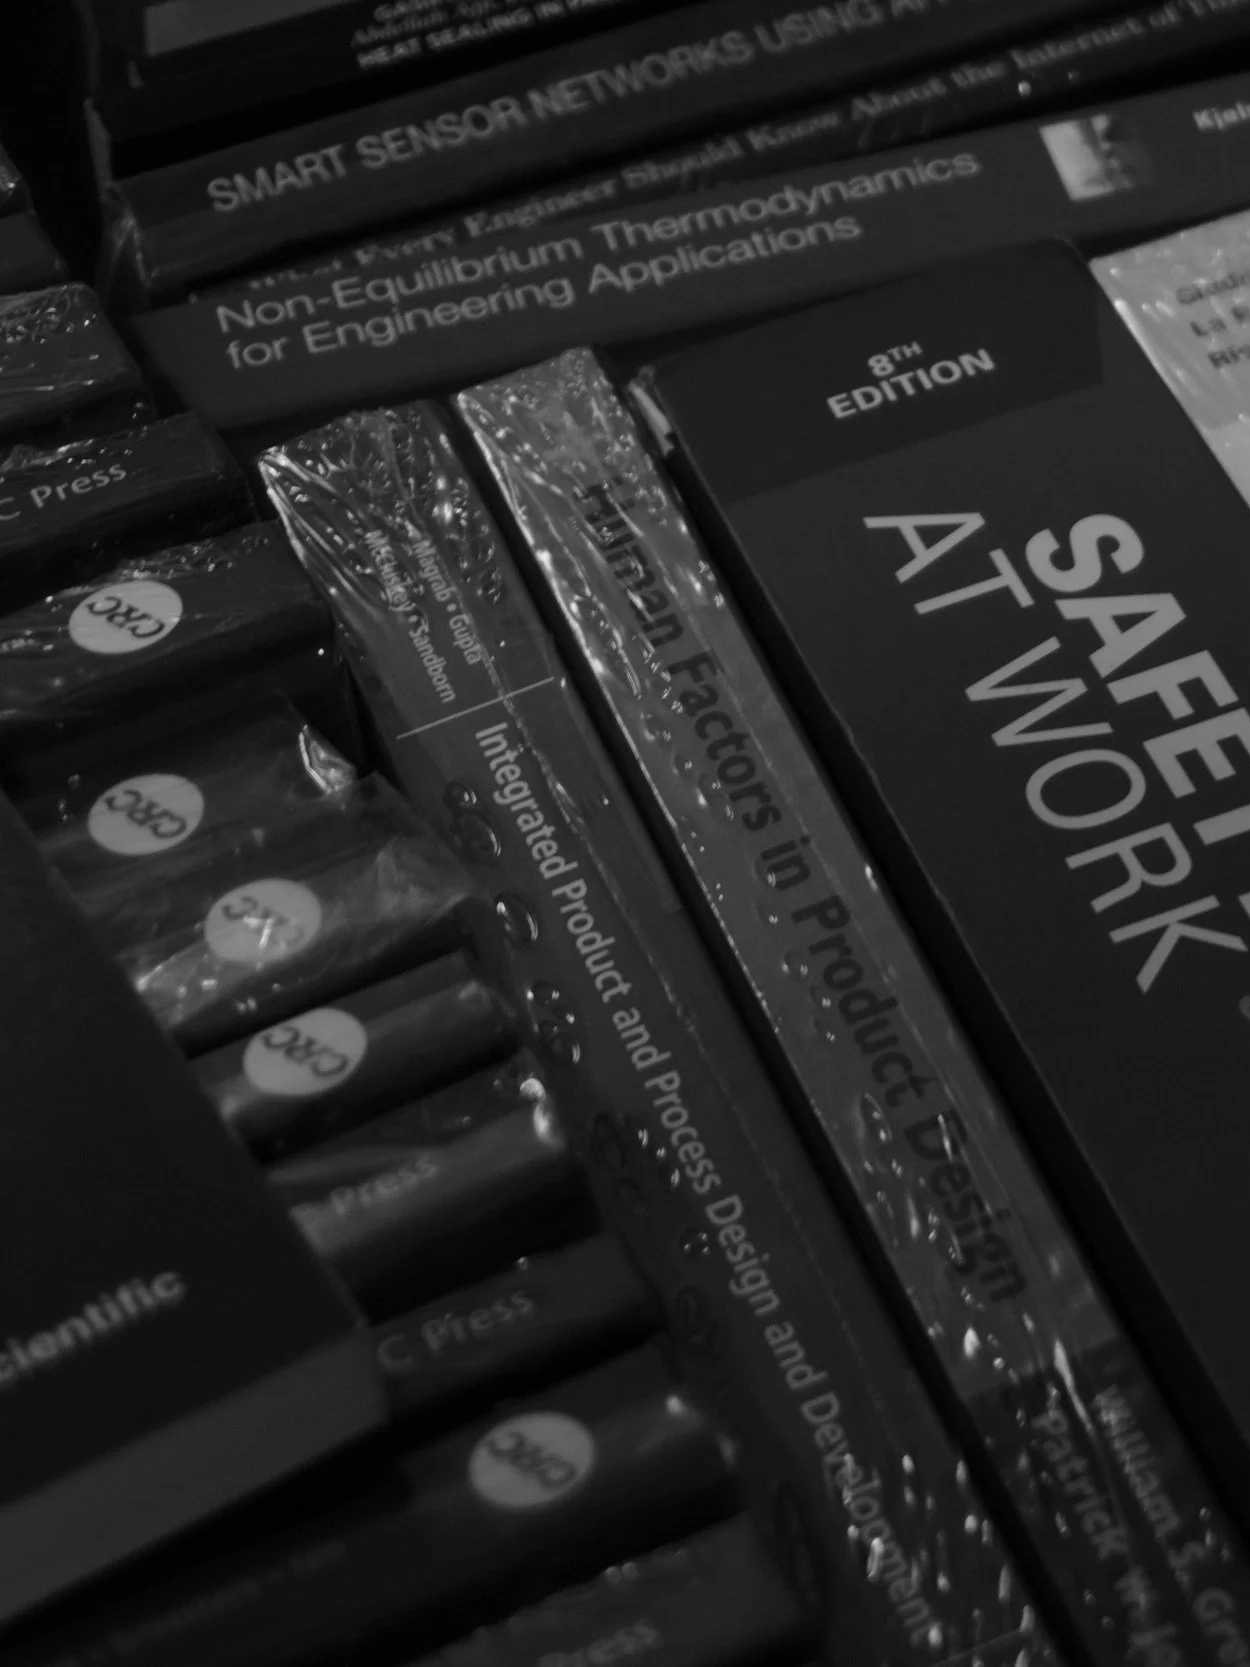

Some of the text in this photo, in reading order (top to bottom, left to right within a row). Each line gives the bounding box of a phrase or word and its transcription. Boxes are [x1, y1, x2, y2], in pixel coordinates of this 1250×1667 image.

[356, 37, 423, 70] HEAT
[425, 6, 534, 50] SEALING
[207, 0, 884, 213] SMART SENSOR NETWORKS USING
[463, 177, 618, 238] Engineer
[622, 135, 742, 192] Should
[746, 108, 841, 155] Know
[850, 76, 948, 122] About
[950, 61, 1006, 88] the
[1010, 17, 1145, 70] Internet
[1148, 3, 1182, 29] of
[215, 151, 982, 334] Non-Equilibrium Thermodynamics
[225, 212, 863, 370] for Engineering Applications
[825, 347, 995, 421] EDITION
[867, 340, 924, 379] 8TH
[29, 463, 128, 509] Press
[86, 596, 166, 640] CRC
[411, 539, 484, 665] Magrab Gupta
[408, 623, 457, 704] Sandborn
[863, 512, 1249, 995] AT WORK
[104, 789, 189, 840] CRC
[573, 482, 1025, 1302] Human Factors in Product Design
[263, 1025, 347, 1078] CRC
[474, 722, 569, 881] Integrated
[552, 878, 632, 1004] Product
[612, 1007, 672, 1073] and
[644, 1068, 723, 1196] Process
[705, 1193, 781, 1319] Design
[763, 1320, 828, 1391] and
[420, 1290, 535, 1358] Press
[1031, 1408, 1132, 1560] Patrick
